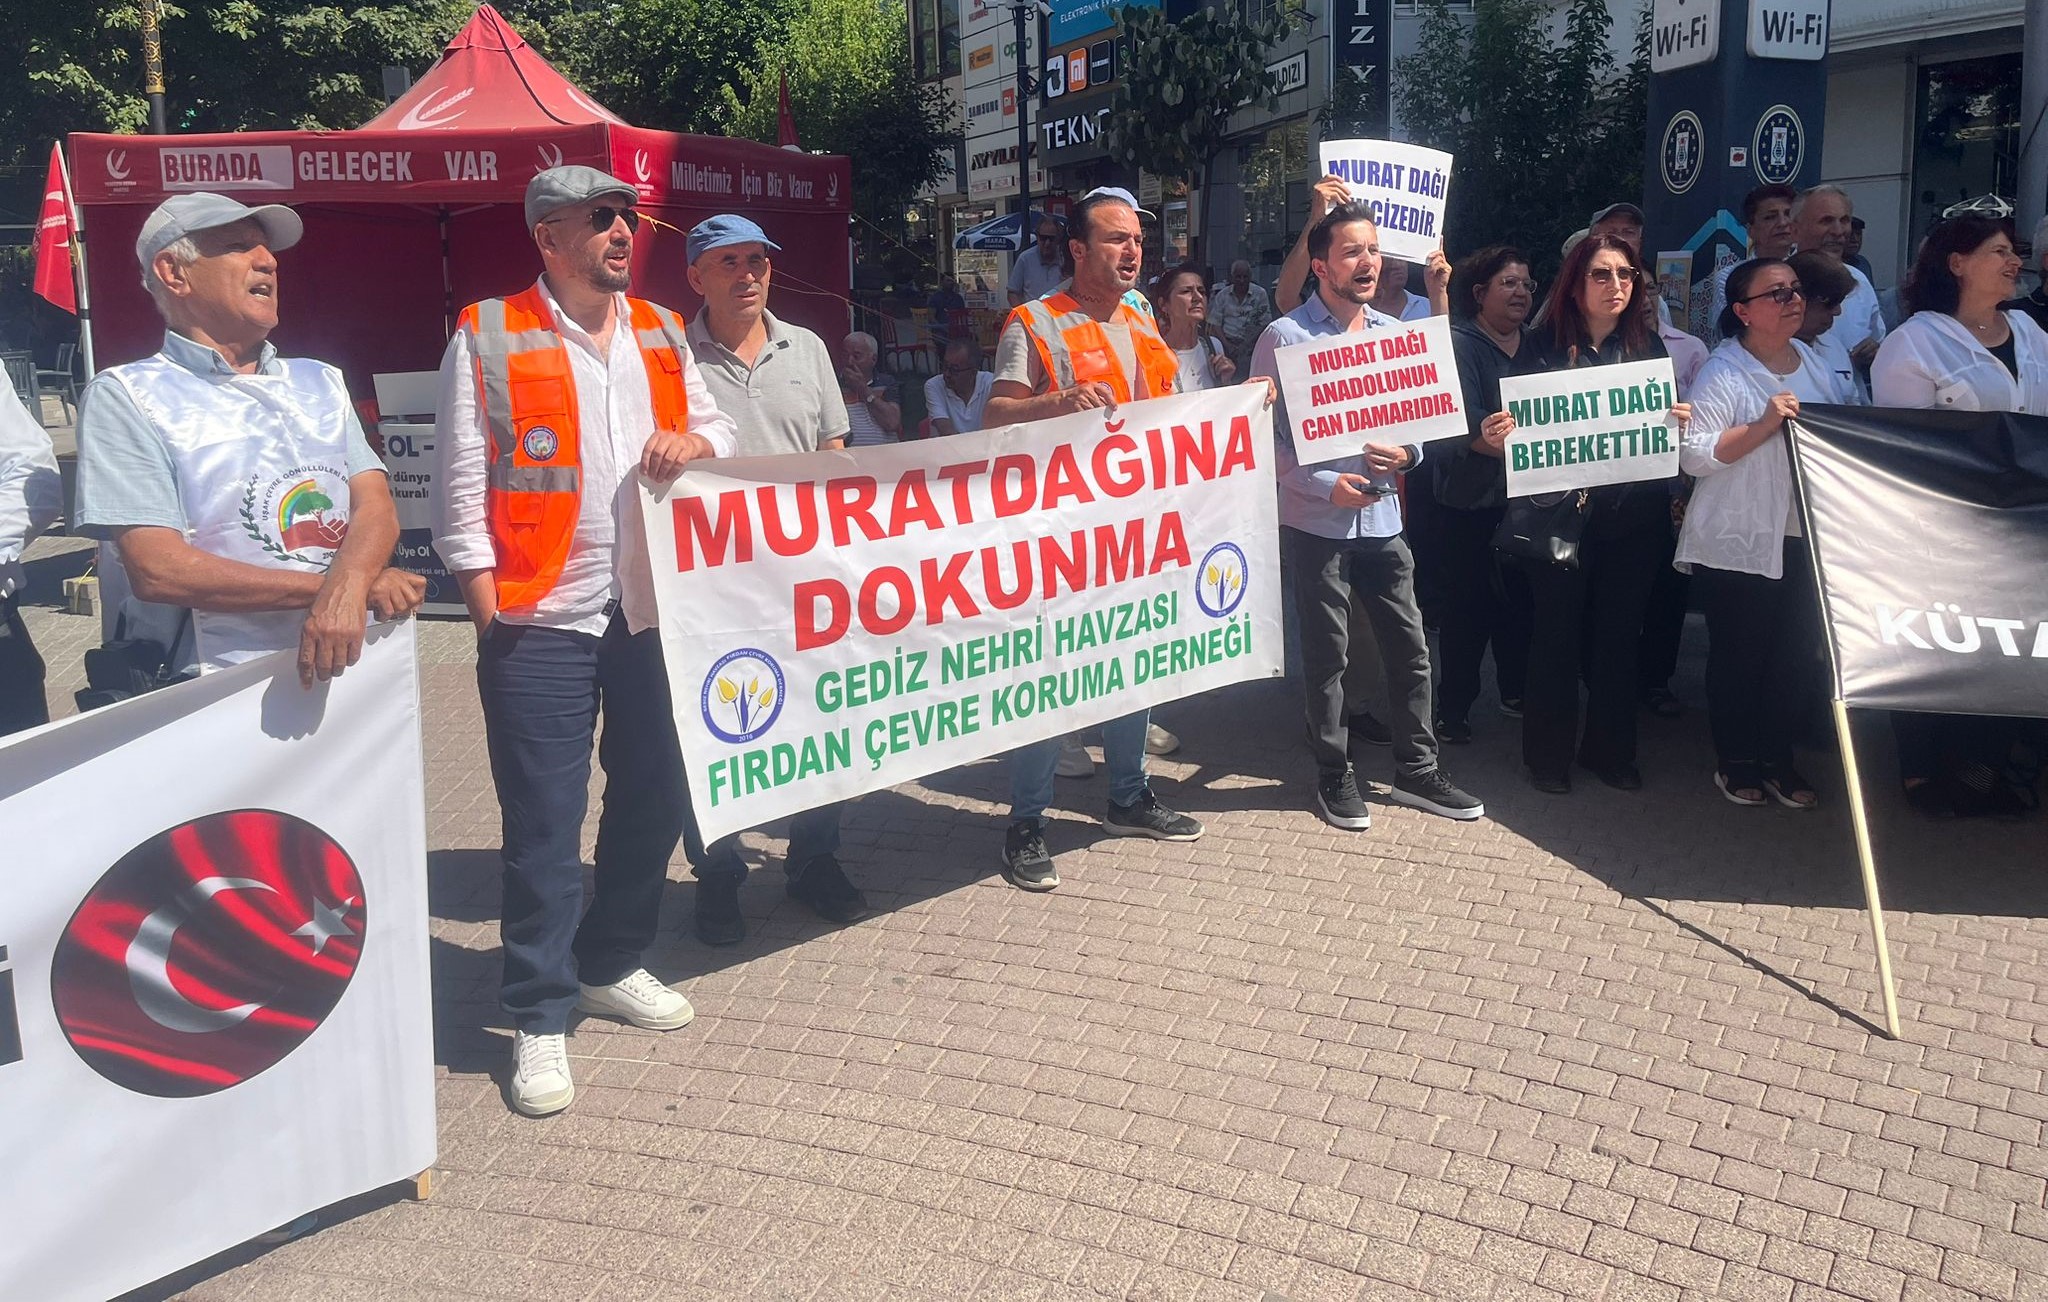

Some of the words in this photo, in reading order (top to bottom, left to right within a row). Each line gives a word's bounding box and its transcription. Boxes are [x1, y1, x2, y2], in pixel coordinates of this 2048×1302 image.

[1656, 14, 1707, 57] Wi-Fi
[1762, 10, 1822, 45] Wi-Fi
[164, 152, 263, 183] BURADA
[298, 150, 413, 182] GELECEK
[444, 150, 498, 181] VAR
[671, 161, 732, 194] Milletimiz
[741, 163, 762, 202] İçin
[767, 171, 782, 198] Biz
[788, 173, 813, 200] Varız
[1328, 159, 1405, 190] MURAT
[1408, 167, 1446, 200] DAĞI
[1351, 196, 1437, 239] CİZEDİR.
[1308, 341, 1377, 375] MURAT
[1379, 328, 1428, 363] DAĞI
[1311, 362, 1439, 407] ANADOLUNUN
[1508, 390, 1602, 428] MURAT
[1608, 377, 1673, 416] DAĞI
[1301, 413, 1346, 441] CAN
[1345, 392, 1459, 433] DAMARIDIR.
[388, 435, 419, 457] OL
[1511, 422, 1676, 472] BEREKETTİR.
[671, 414, 1256, 573] MURATDAĞINA
[417, 545, 430, 557] Ol
[793, 510, 1192, 653] DOKUNMA
[815, 646, 929, 713] GEDİZ
[941, 615, 1043, 685] NEHRİ
[1055, 590, 1178, 657] HAVZASI
[707, 727, 852, 808] FIRDAN
[864, 694, 980, 771] ÇEVRE
[992, 656, 1125, 727] KORUMA
[1134, 612, 1252, 686] DERNEĞİ
